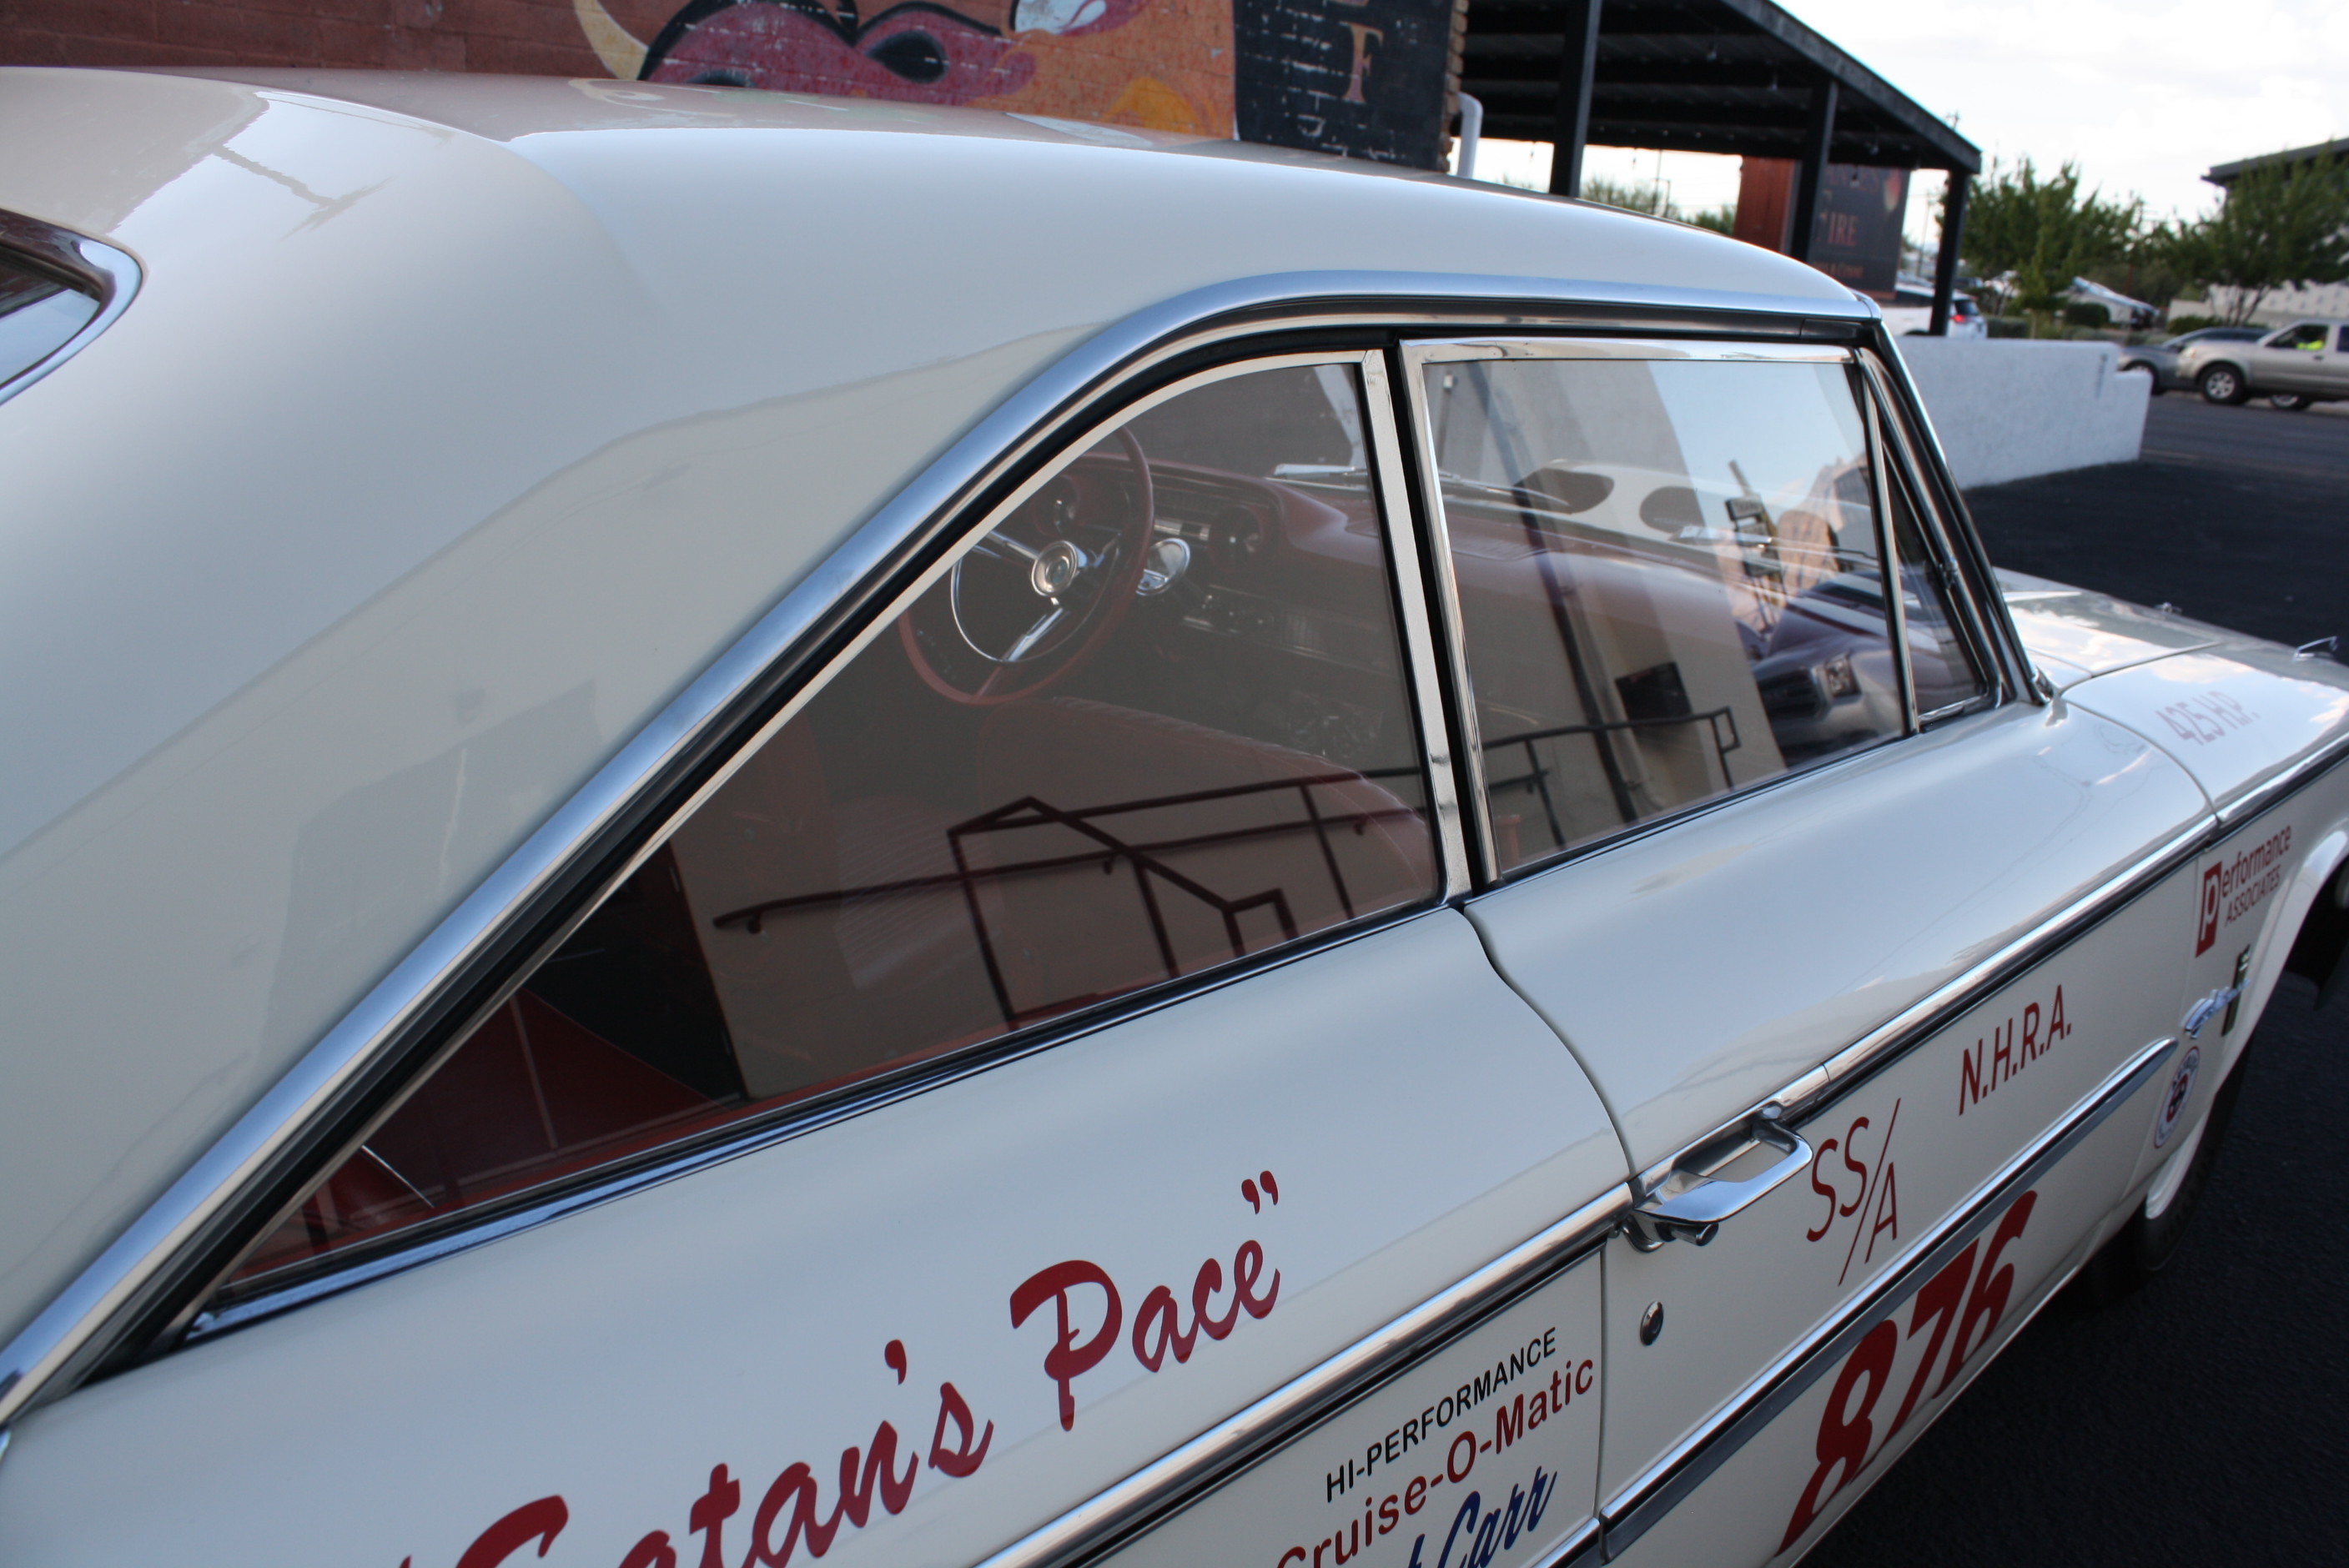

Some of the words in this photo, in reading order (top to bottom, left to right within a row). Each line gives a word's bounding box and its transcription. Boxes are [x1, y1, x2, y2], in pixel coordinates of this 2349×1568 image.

[2155, 701, 2226, 746] 425
[2225, 864, 2281, 928] ASSOCIATES
[1959, 984, 2072, 1116] N.H.R.A.
[1326, 1327, 1557, 1503] HI-PERFORMANCE
[1775, 1190, 2039, 1558] 876
[1436, 1465, 1557, 1568] Carr
